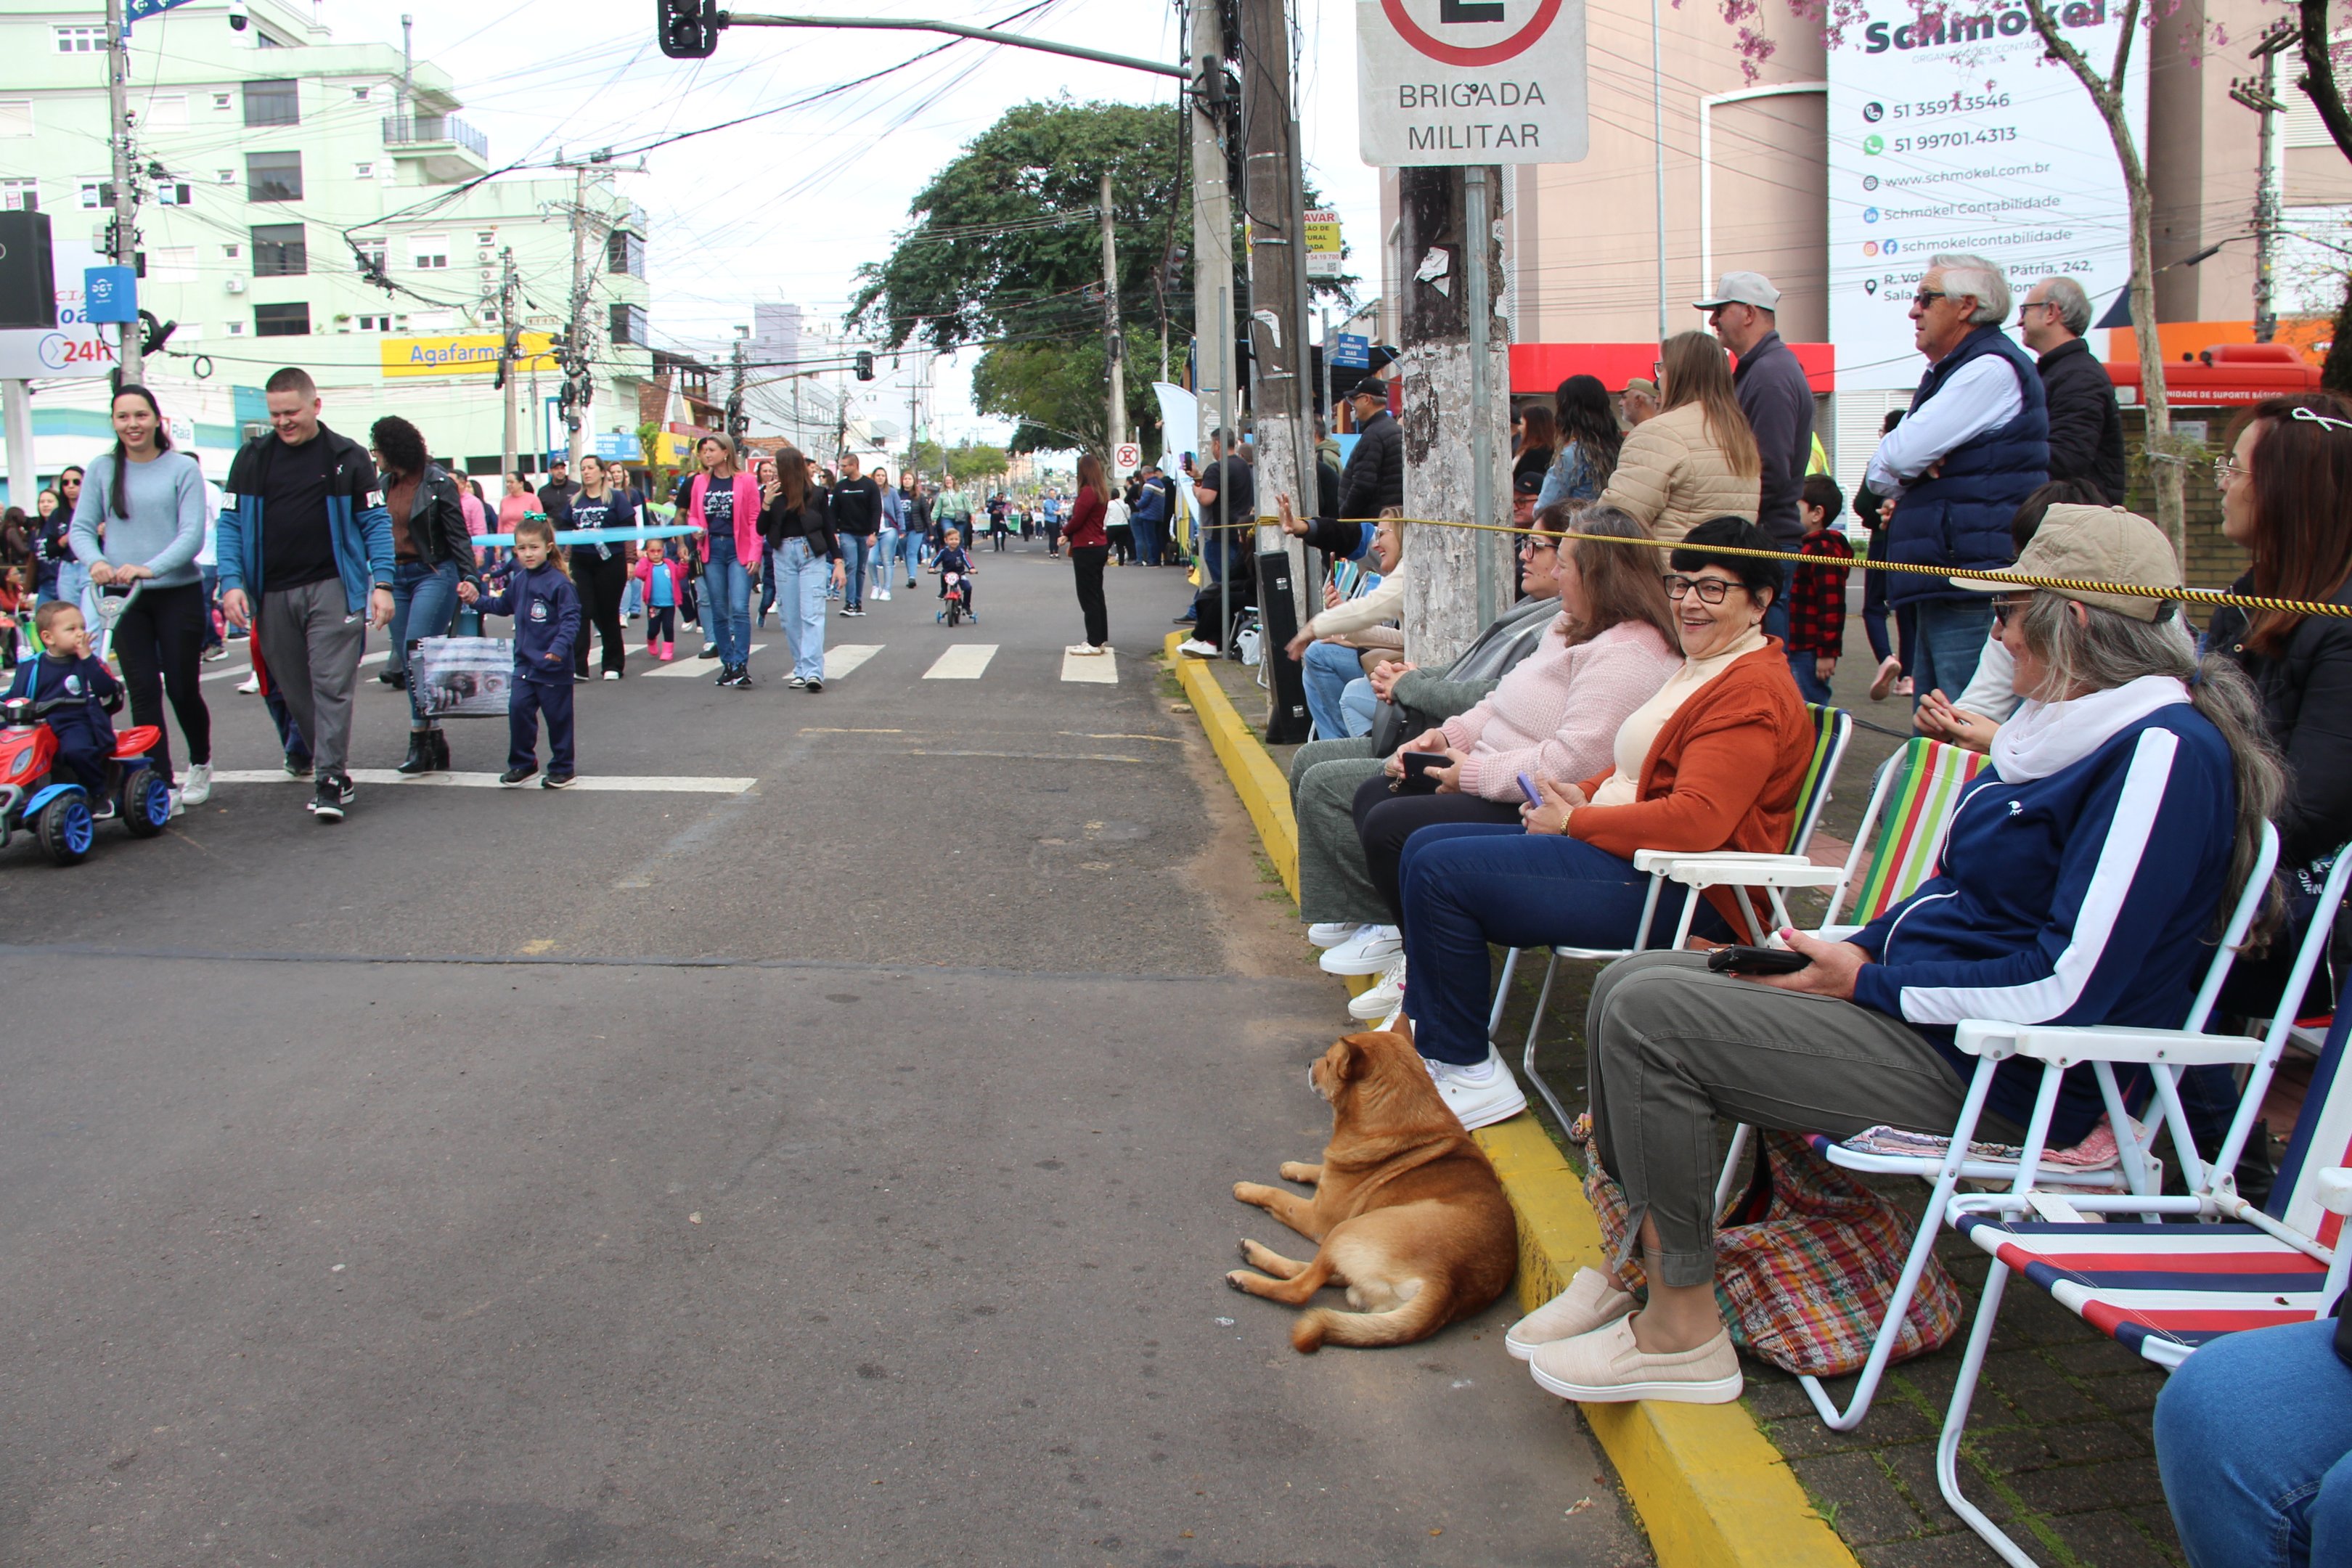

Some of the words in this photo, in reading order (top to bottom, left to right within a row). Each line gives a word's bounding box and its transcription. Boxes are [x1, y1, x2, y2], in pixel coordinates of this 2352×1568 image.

[1400, 82, 1545, 108] BRIGADA
[1892, 105, 1910, 119] 51
[1916, 93, 2010, 117] 35973546
[1409, 123, 1540, 150] MILITAR
[1894, 138, 1911, 152] 51
[1917, 126, 2017, 150] 99701.4313
[1885, 162, 2051, 187] www.schmokel.com.br
[1304, 213, 1335, 222] AVAR
[1884, 203, 1954, 221] Schmökel
[1957, 195, 2061, 215] Contabilidade
[1902, 229, 2073, 253] schmokelcontabilidade
[1884, 274, 1898, 285] R.
[2062, 260, 2094, 274] 242,
[1884, 290, 1913, 301] Sala
[63, 339, 113, 362] 24h
[410, 343, 505, 367] Agafarma
[2166, 390, 2198, 399] NIDADE
[2212, 391, 2250, 399] SUPORTE
